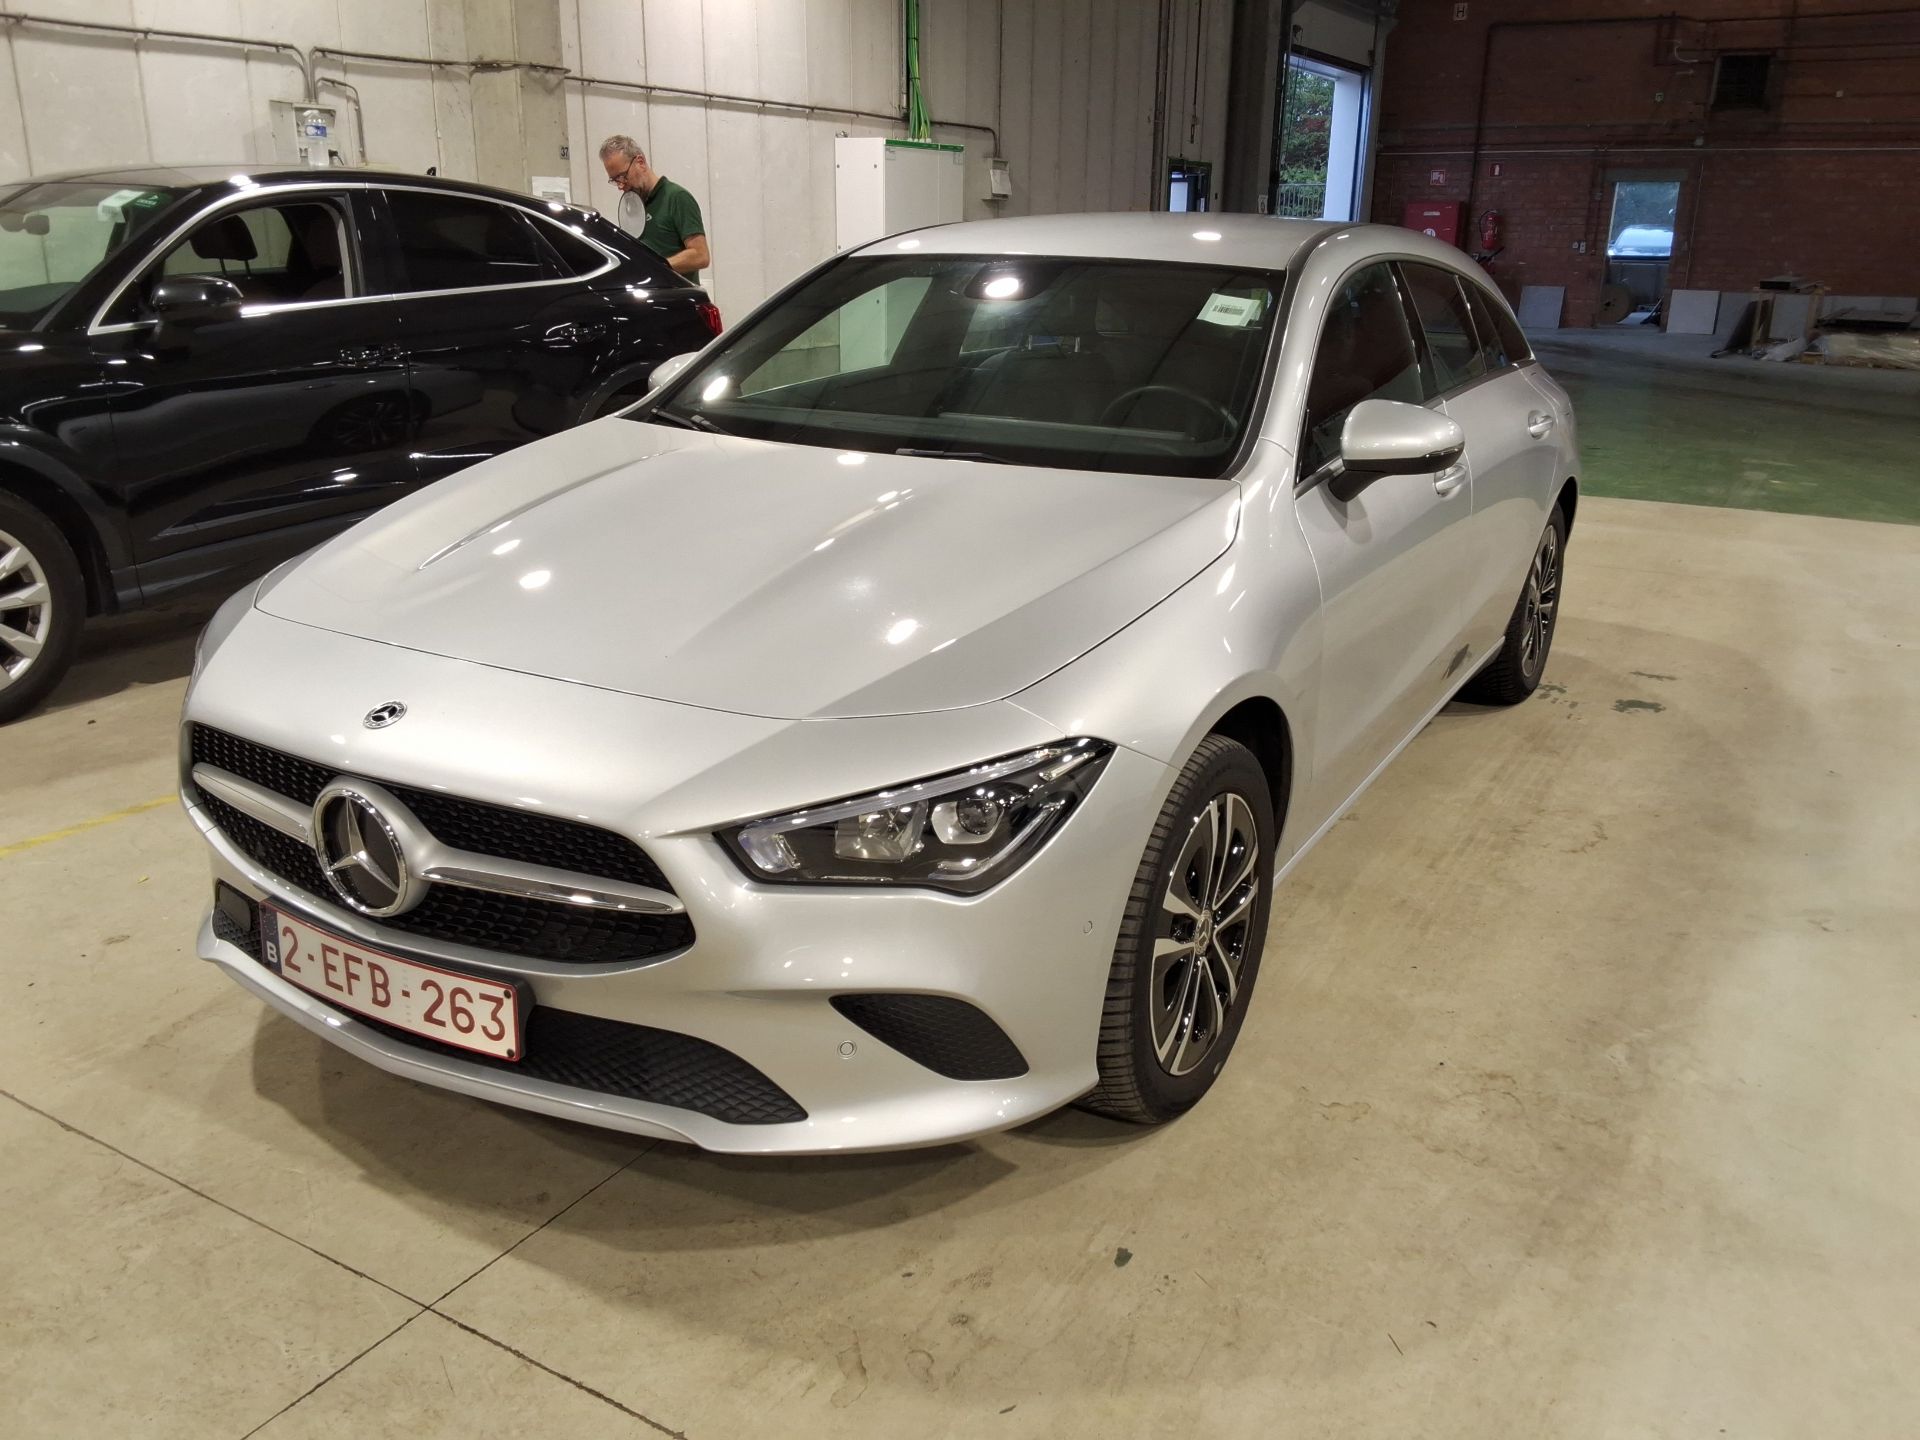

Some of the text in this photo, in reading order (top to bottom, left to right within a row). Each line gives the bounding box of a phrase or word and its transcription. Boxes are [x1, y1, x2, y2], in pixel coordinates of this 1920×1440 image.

[560, 146, 569, 158] 37
[266, 941, 278, 963] B
[282, 926, 506, 1042] 2-EFB-263
